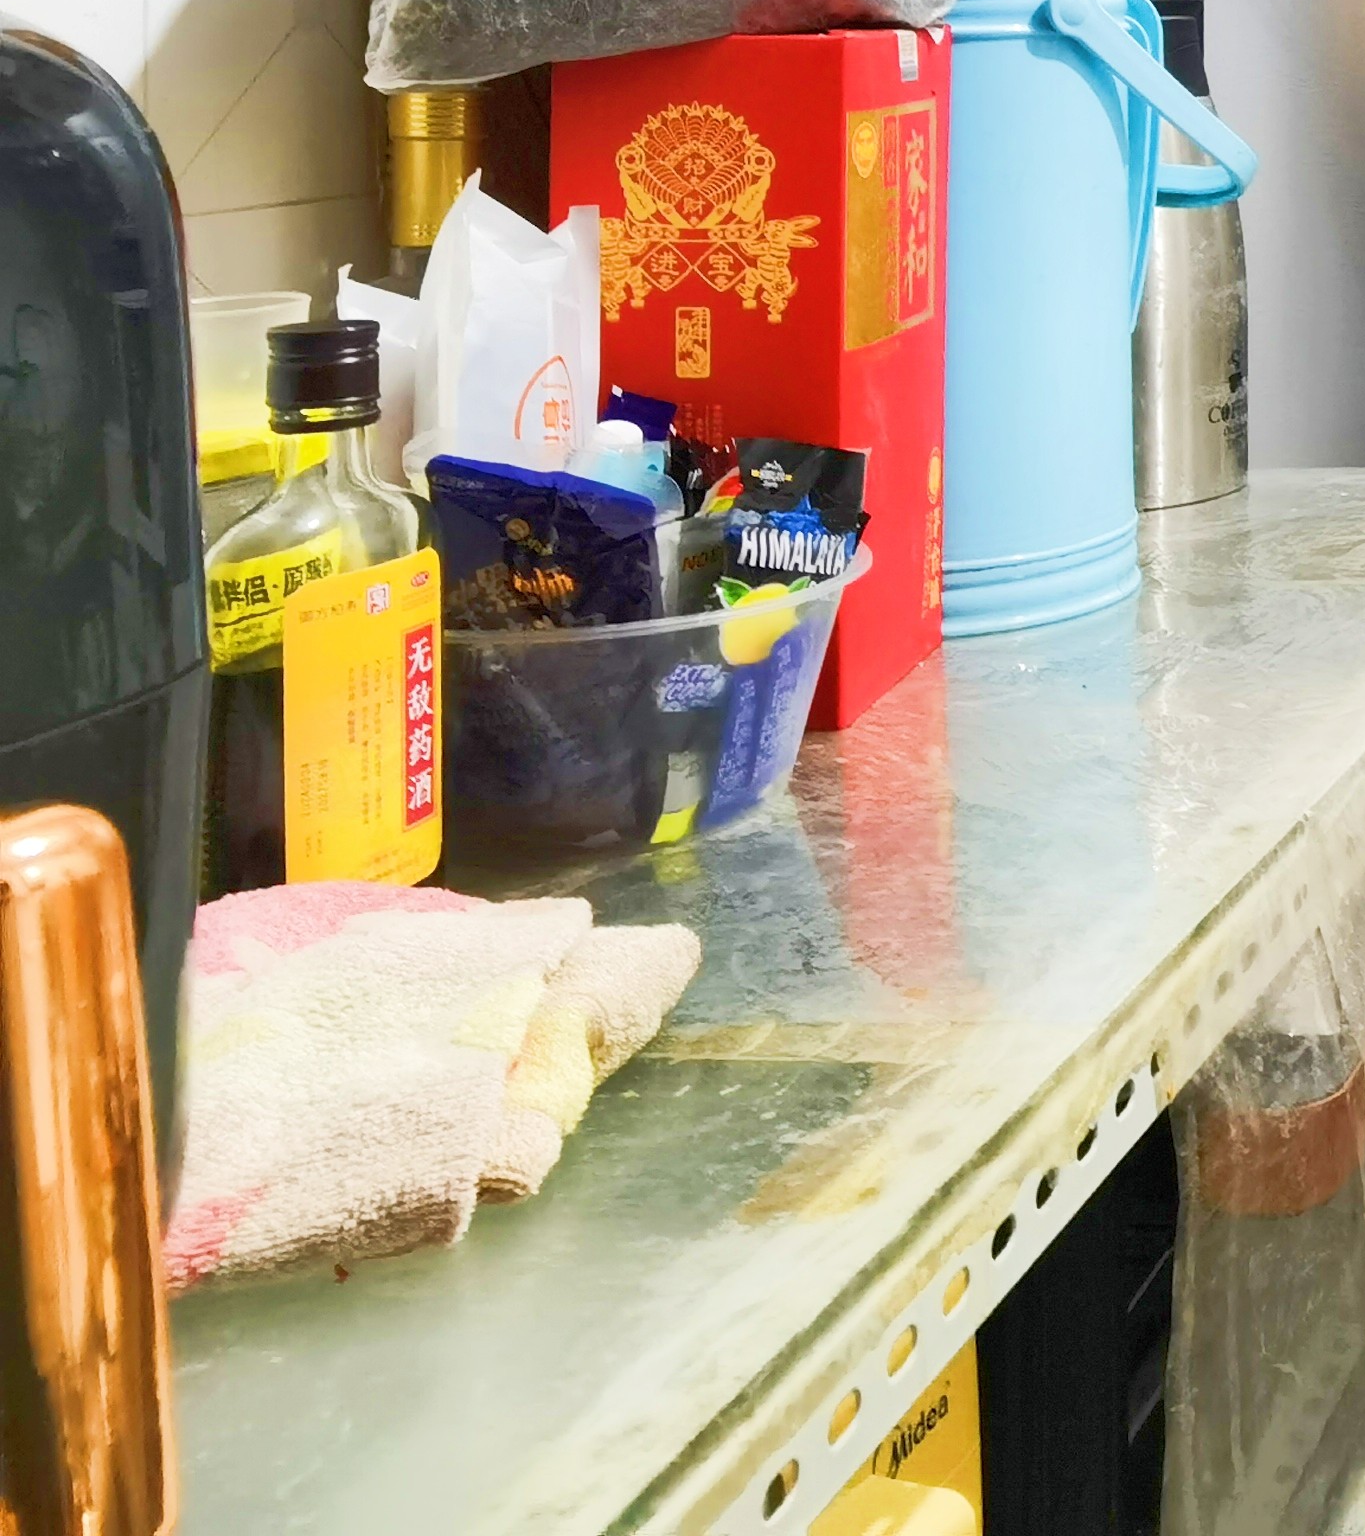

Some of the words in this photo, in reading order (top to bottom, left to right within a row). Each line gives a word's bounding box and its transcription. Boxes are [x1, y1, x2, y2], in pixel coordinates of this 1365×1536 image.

[683, 157, 707, 177] 招
[683, 196, 707, 216] 财
[650, 251, 680, 275] 进
[707, 252, 735, 276] 宝
[737, 525, 848, 576] HIMALAYA
[406, 636, 435, 811] 无敌药酒
[886, 1394, 949, 1480] Midea
